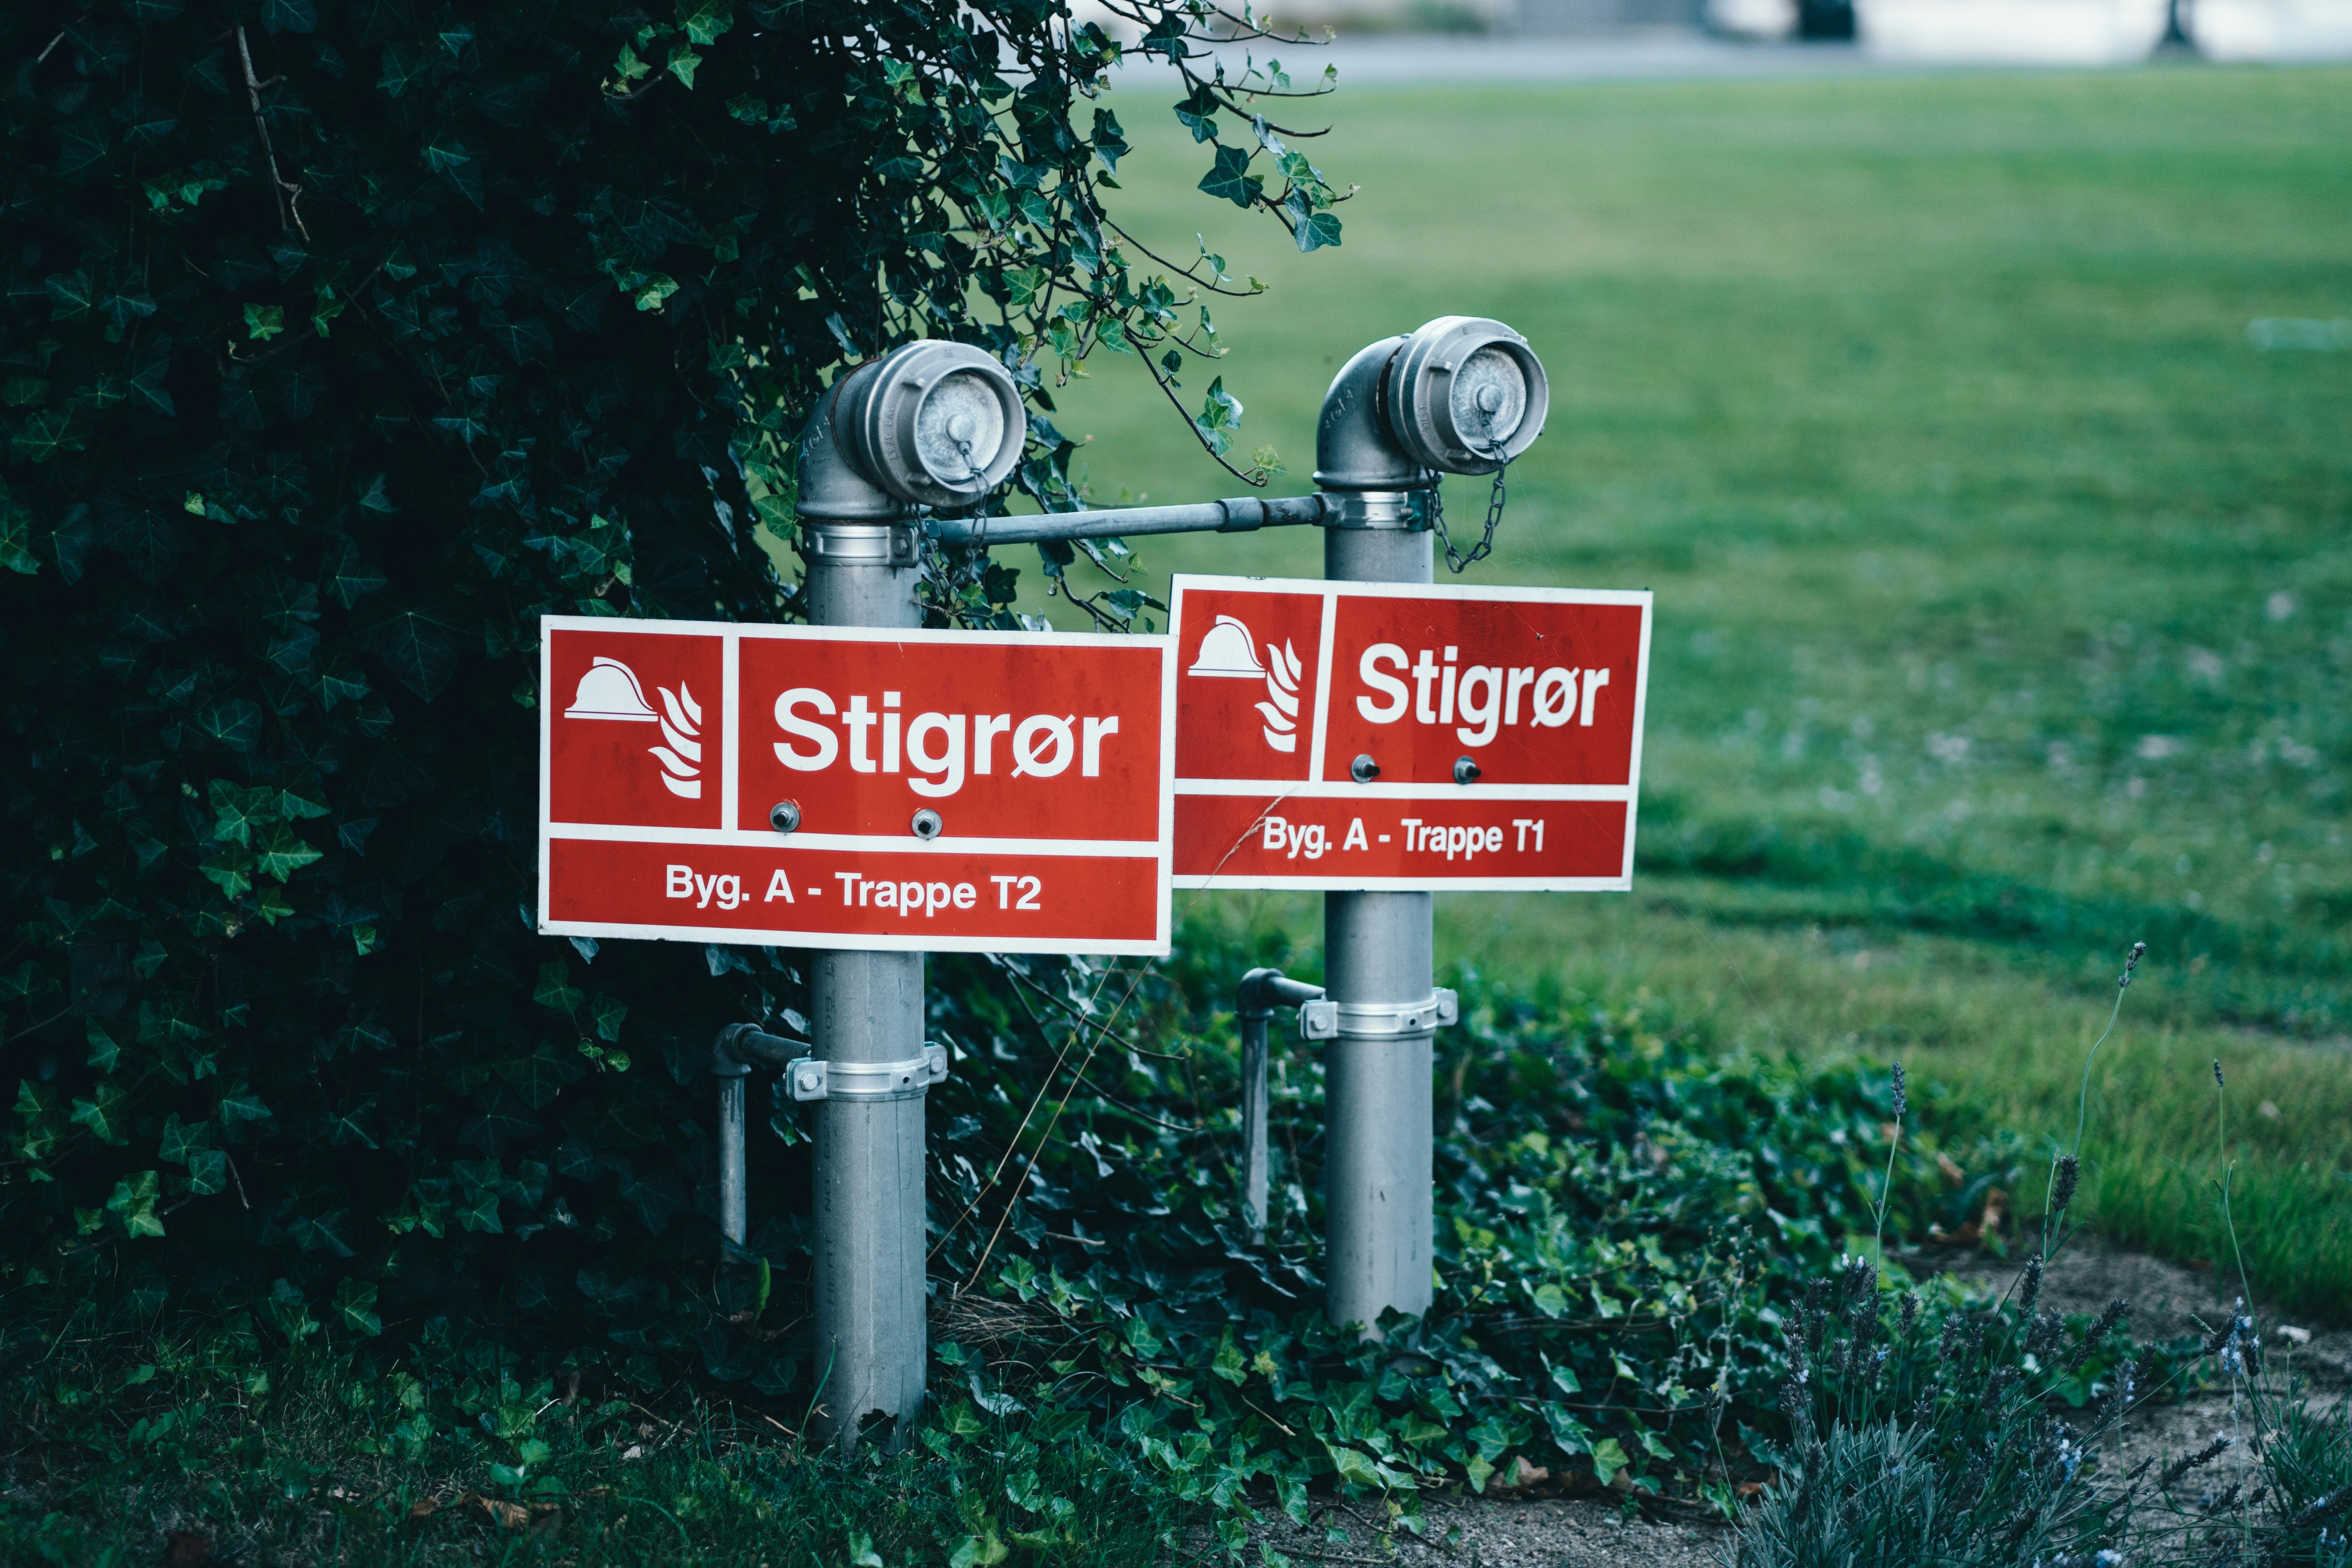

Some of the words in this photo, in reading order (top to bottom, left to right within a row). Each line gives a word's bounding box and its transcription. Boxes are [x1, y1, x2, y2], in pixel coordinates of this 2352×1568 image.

[1356, 643, 1610, 747] Stigrør
[773, 688, 1119, 798] Stigrør
[1262, 816, 1332, 860] Byg.
[1342, 817, 1369, 851] A
[1378, 834, 1391, 843] -
[1400, 818, 1504, 861] Trappe
[1512, 819, 1544, 852] T1
[666, 864, 750, 910] Byg.
[764, 869, 795, 903] A
[808, 888, 821, 896] -
[835, 871, 977, 917] Trappe
[990, 875, 1041, 910] T2
[825, 1234, 835, 1306] HEAT
